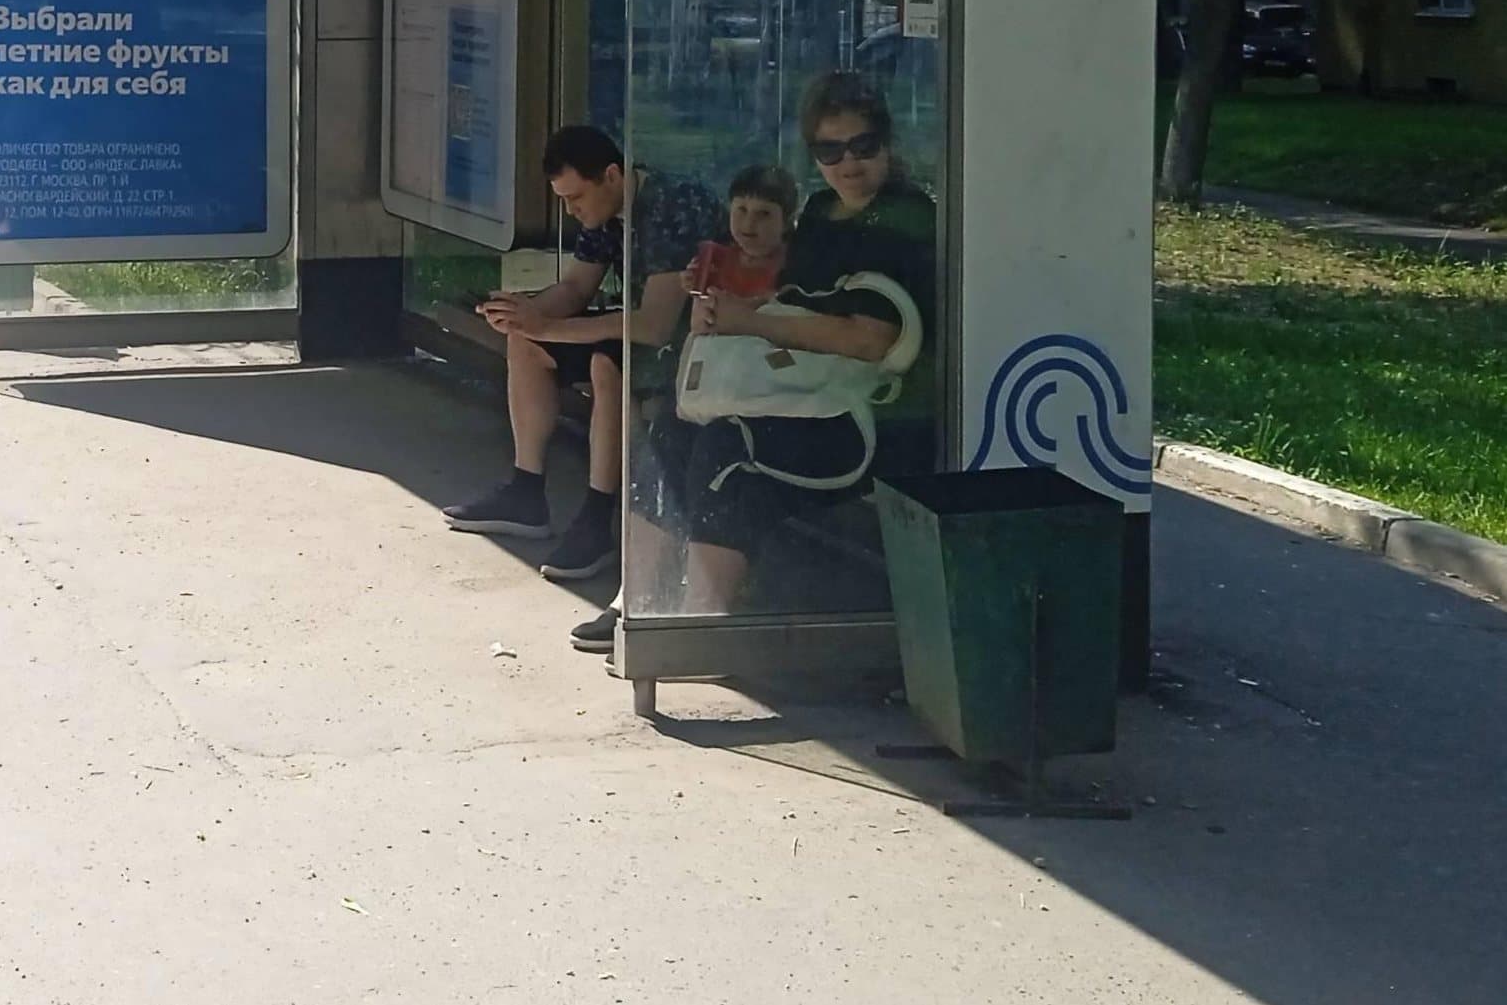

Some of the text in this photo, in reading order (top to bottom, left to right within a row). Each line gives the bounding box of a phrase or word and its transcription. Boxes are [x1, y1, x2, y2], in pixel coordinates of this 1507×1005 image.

[107, 38, 229, 69] фрукты
[49, 76, 109, 100] для
[115, 71, 186, 95] себя
[62, 143, 105, 156] ТОВАРА
[61, 159, 86, 171] ООО
